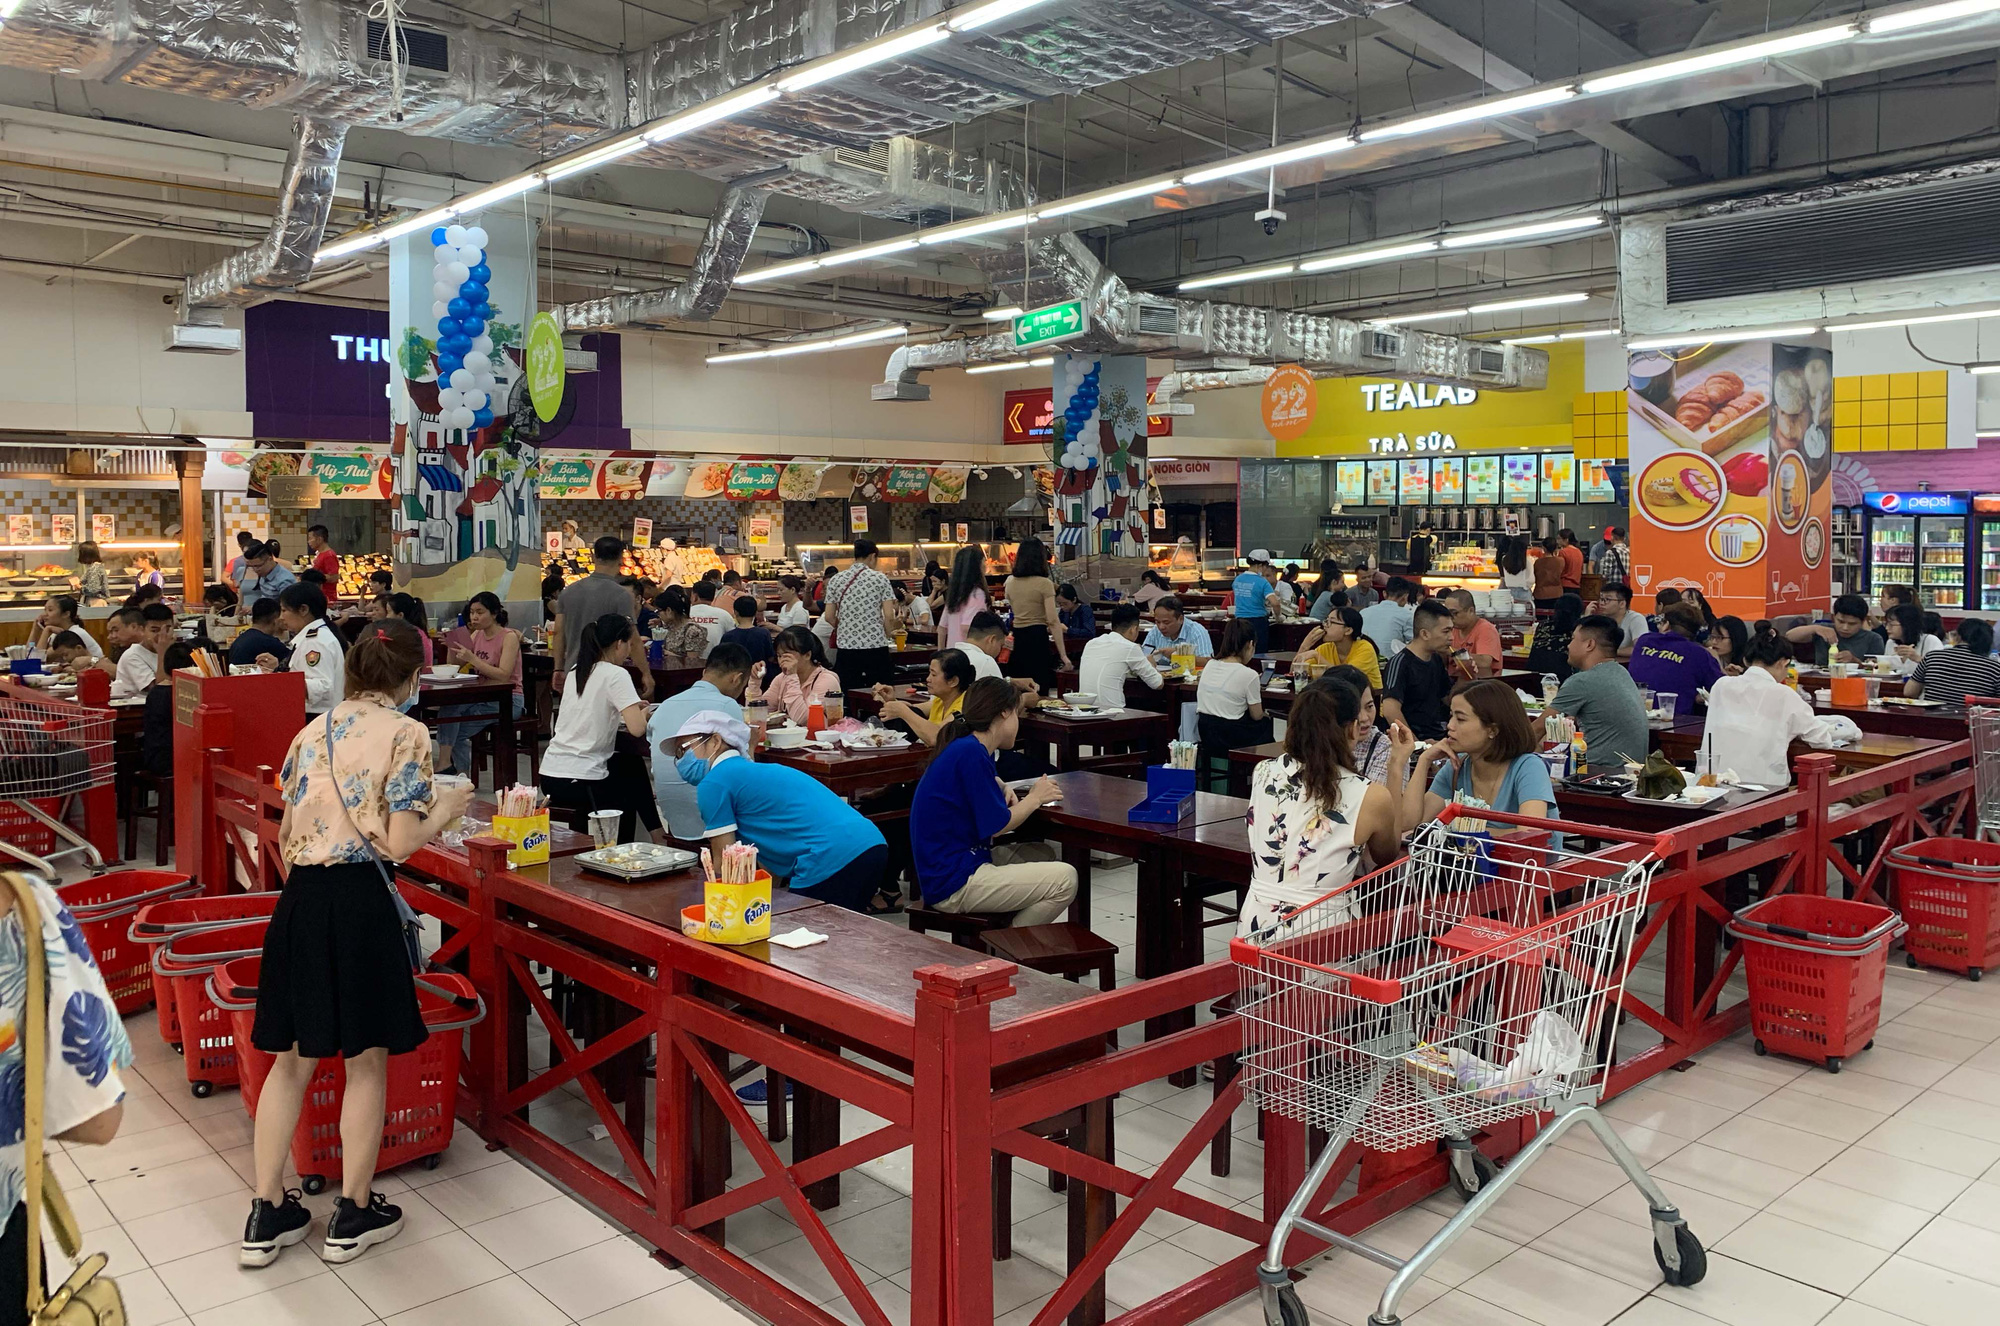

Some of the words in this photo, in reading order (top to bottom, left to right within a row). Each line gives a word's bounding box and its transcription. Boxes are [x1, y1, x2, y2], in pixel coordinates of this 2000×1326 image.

[1039, 325, 1057, 337] EXIT
[1271, 382, 1308, 421] 22
[1368, 433, 1409, 453] TRÀ
[1415, 431, 1457, 451] SỮA
[558, 464, 578, 474] Bún
[542, 473, 567, 484] Bánh
[568, 474, 589, 484] cuốn
[1908, 494, 1951, 510] pepsi
[744, 903, 770, 925] Fanta
